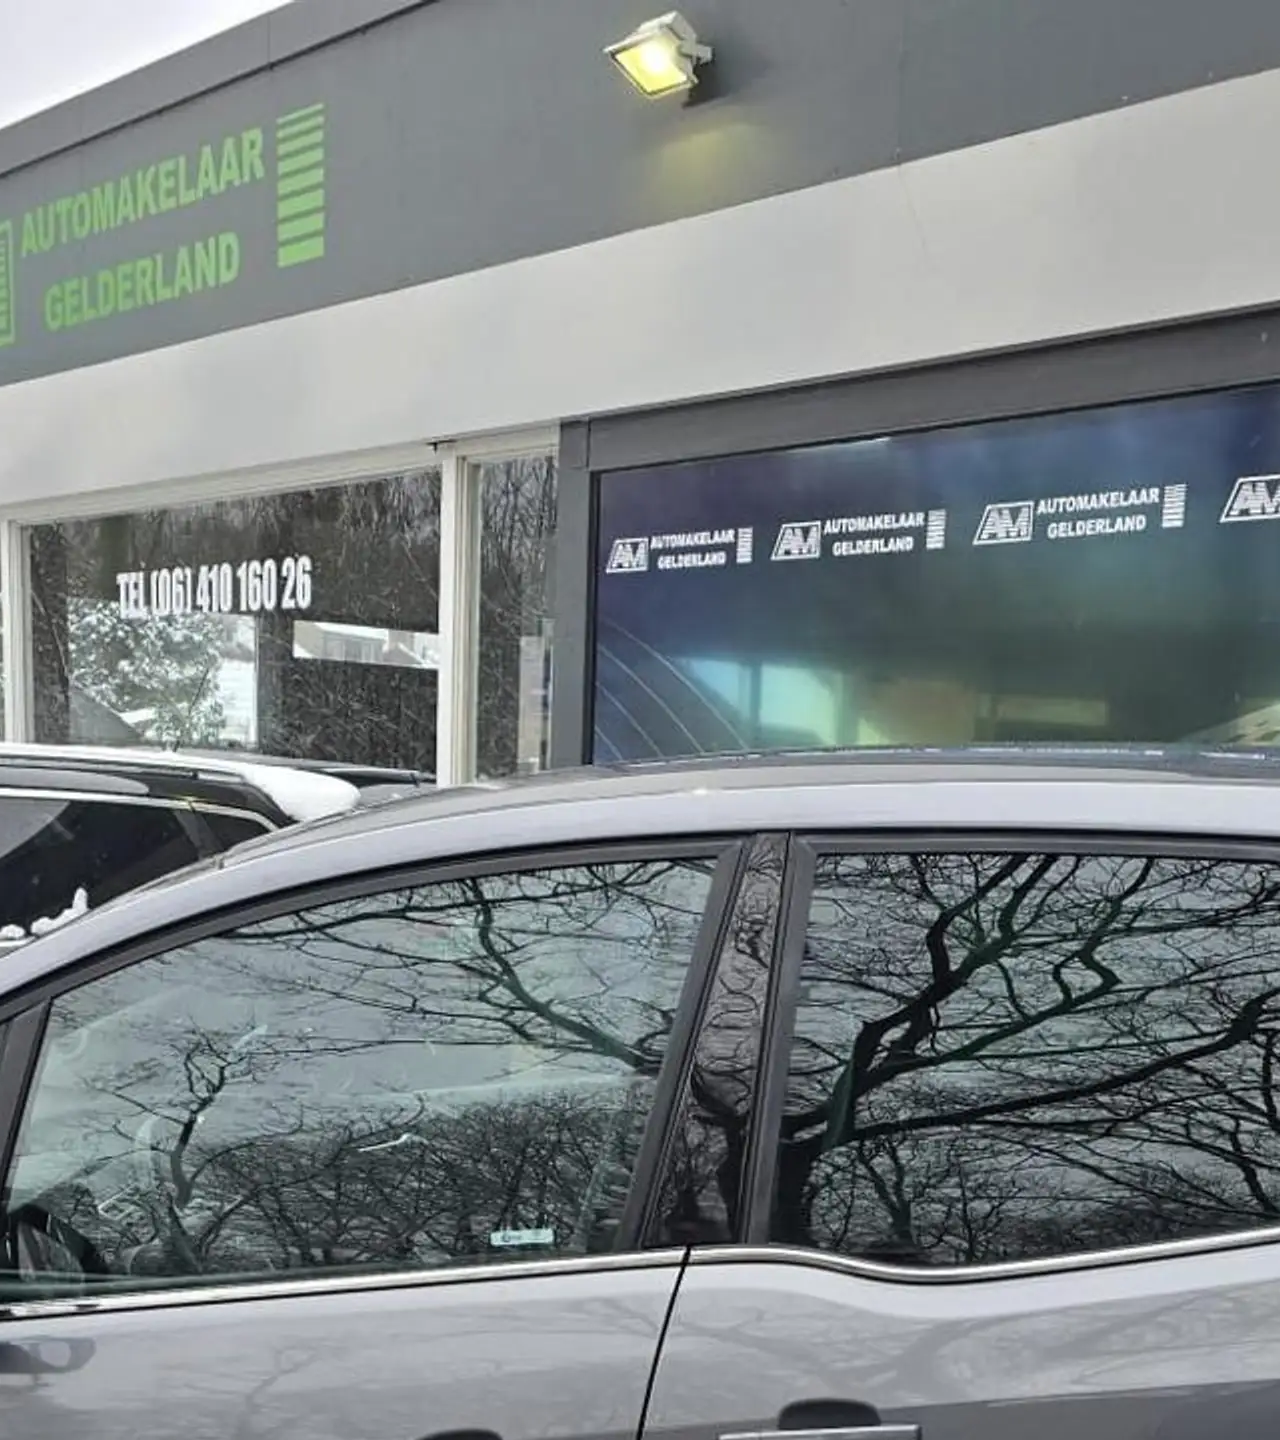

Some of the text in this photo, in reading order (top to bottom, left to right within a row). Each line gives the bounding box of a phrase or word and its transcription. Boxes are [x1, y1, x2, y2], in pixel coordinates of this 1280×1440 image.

[22, 126, 265, 258] AUTOMAKELAAR
[44, 231, 241, 332] GELDERLAND
[1036, 487, 1161, 516] AUTOMAKELAAR
[823, 512, 926, 537] AUTOMAKELAAR
[1047, 515, 1147, 540] GELDERLAND
[649, 528, 736, 551] AUTOMAKELAAR
[832, 536, 914, 557] GELDERLAND
[657, 551, 727, 571] GELDERLAND
[116, 571, 147, 619] TEL
[196, 562, 233, 613] 410
[236, 558, 278, 612] 160
[281, 555, 313, 610] 26
